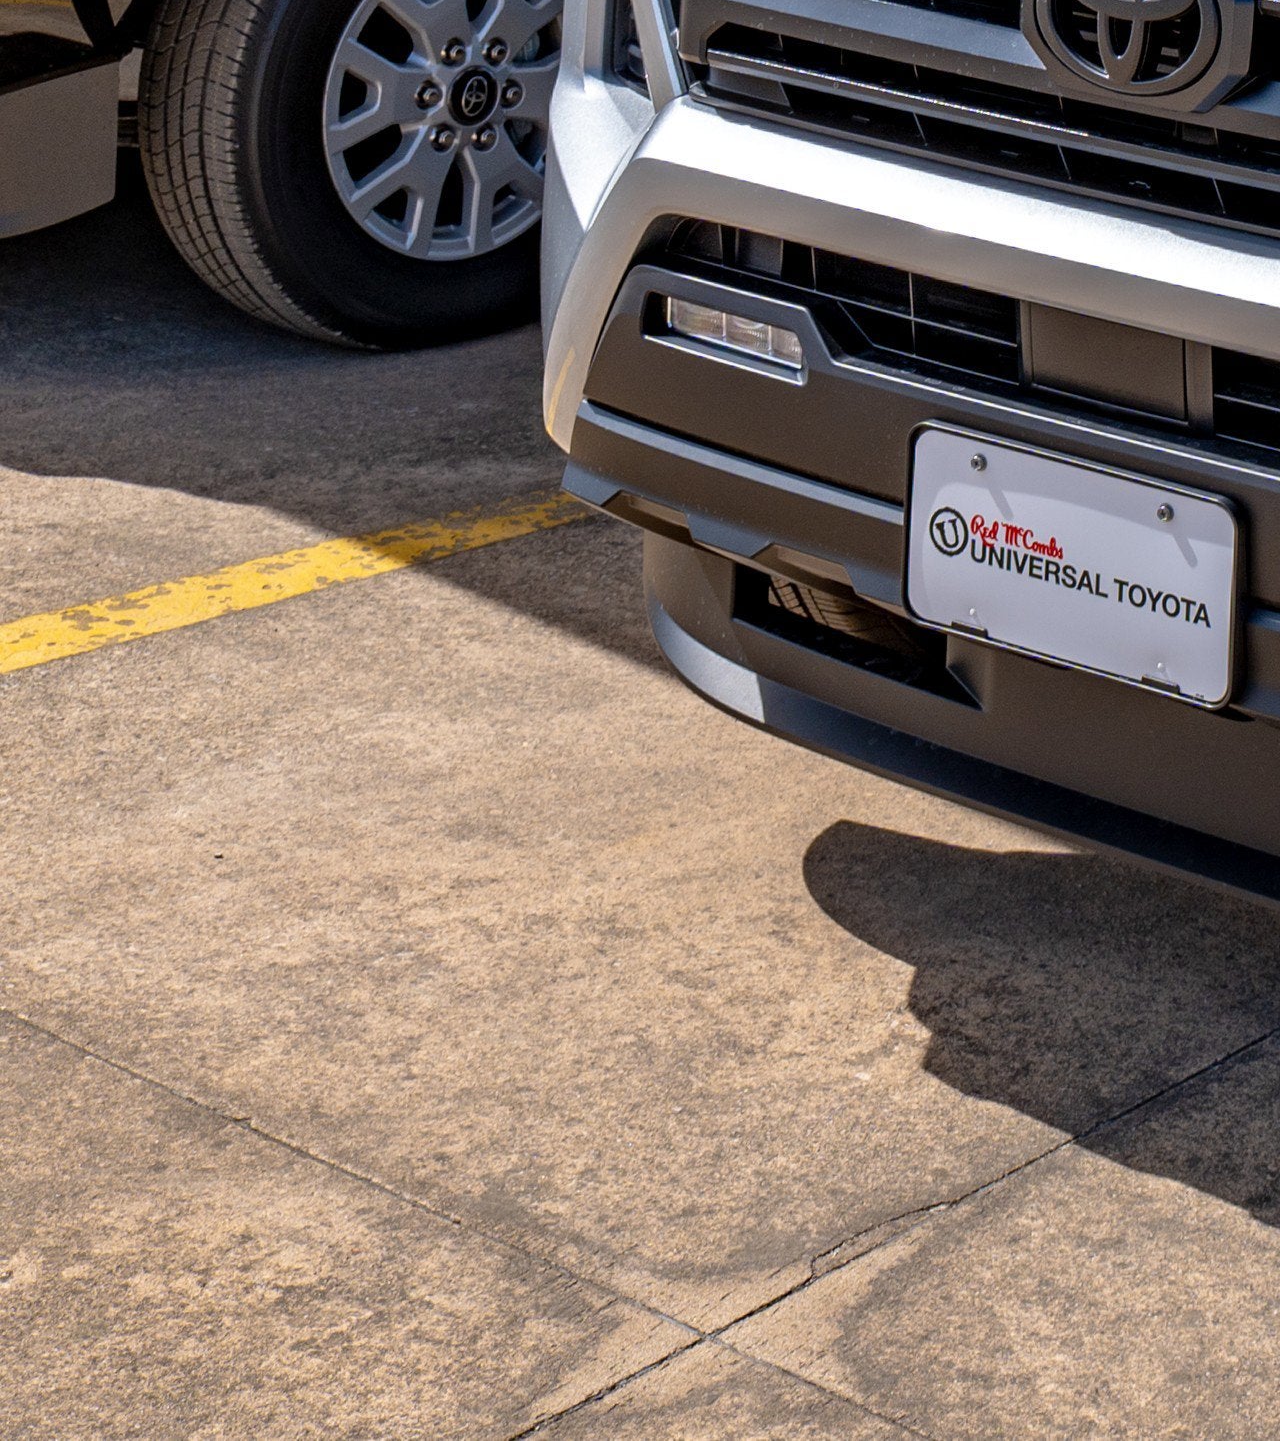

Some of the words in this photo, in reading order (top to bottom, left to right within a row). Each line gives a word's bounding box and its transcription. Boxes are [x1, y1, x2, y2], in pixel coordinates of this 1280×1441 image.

[971, 514, 999, 547] Red
[1001, 521, 1064, 559] McCombs
[970, 538, 1108, 599] UNIVERSAL
[1114, 578, 1211, 628] TOYOTA
